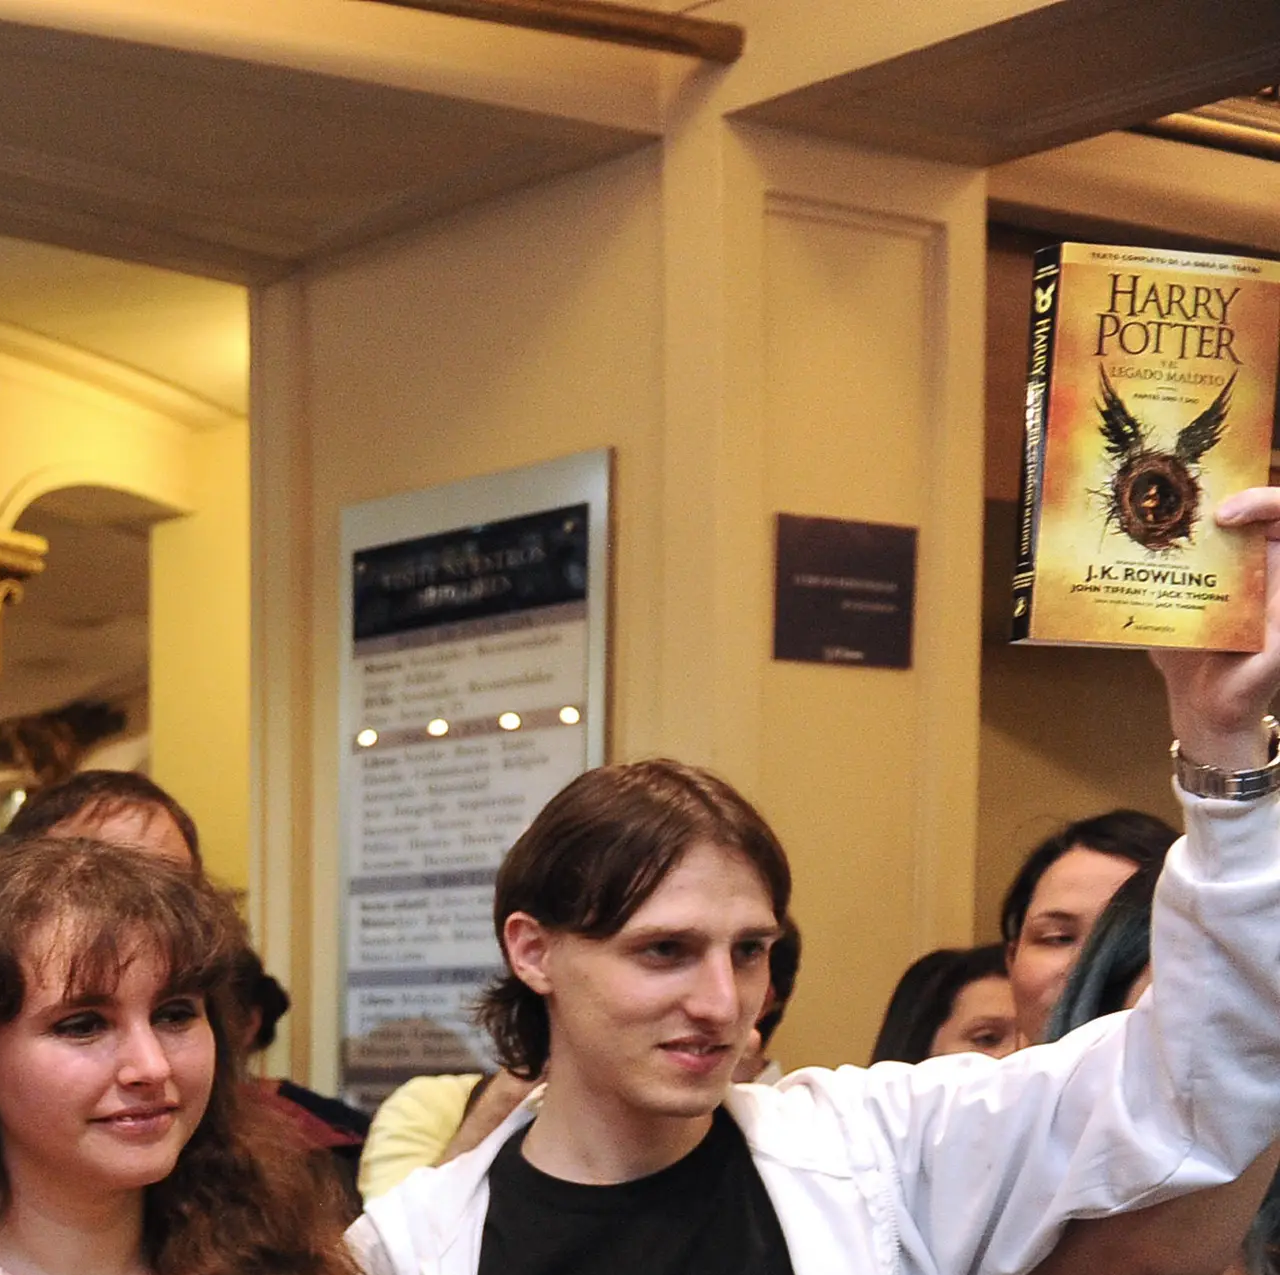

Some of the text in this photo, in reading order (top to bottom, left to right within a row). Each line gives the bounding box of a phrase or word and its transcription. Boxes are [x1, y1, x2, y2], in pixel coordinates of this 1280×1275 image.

[1108, 272, 1243, 325] HARRY
[1092, 312, 1244, 366] POTTER
[1111, 366, 1226, 387] LEGADO MALDITO
[1123, 568, 1217, 588] ROWLING
[1070, 584, 1231, 602] JOHN TIFFANY JACK THORNE
